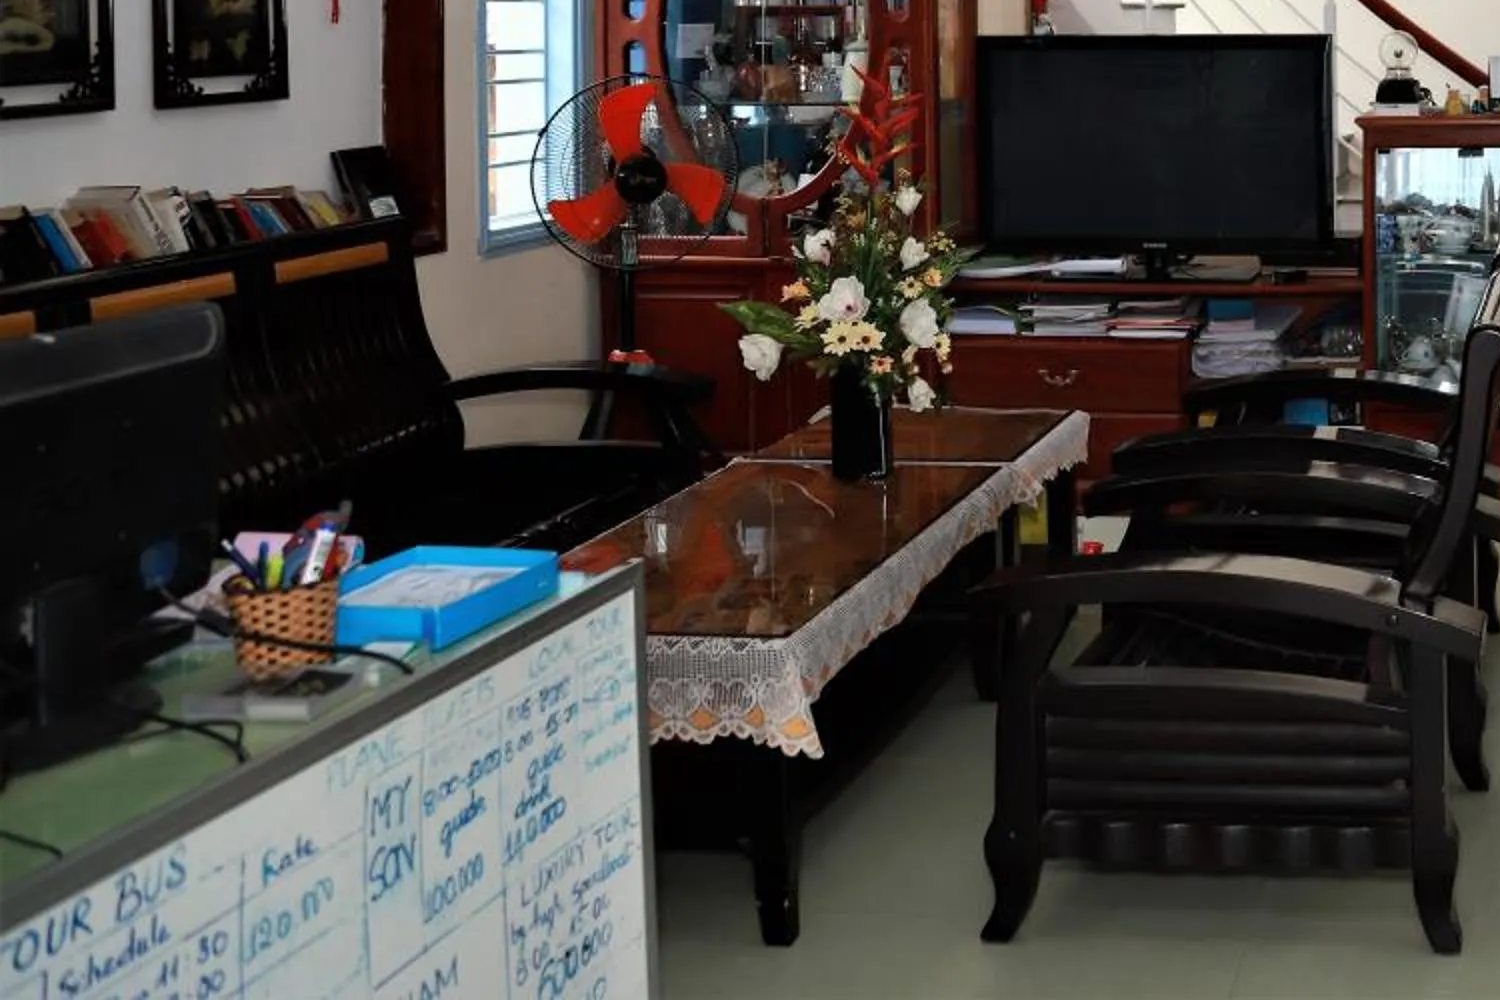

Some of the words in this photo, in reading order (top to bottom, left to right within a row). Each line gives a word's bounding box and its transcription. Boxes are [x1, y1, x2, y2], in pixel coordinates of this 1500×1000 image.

[370, 775, 412, 837] MY
[0, 896, 93, 973] OUR
[113, 846, 188, 923] BUS
